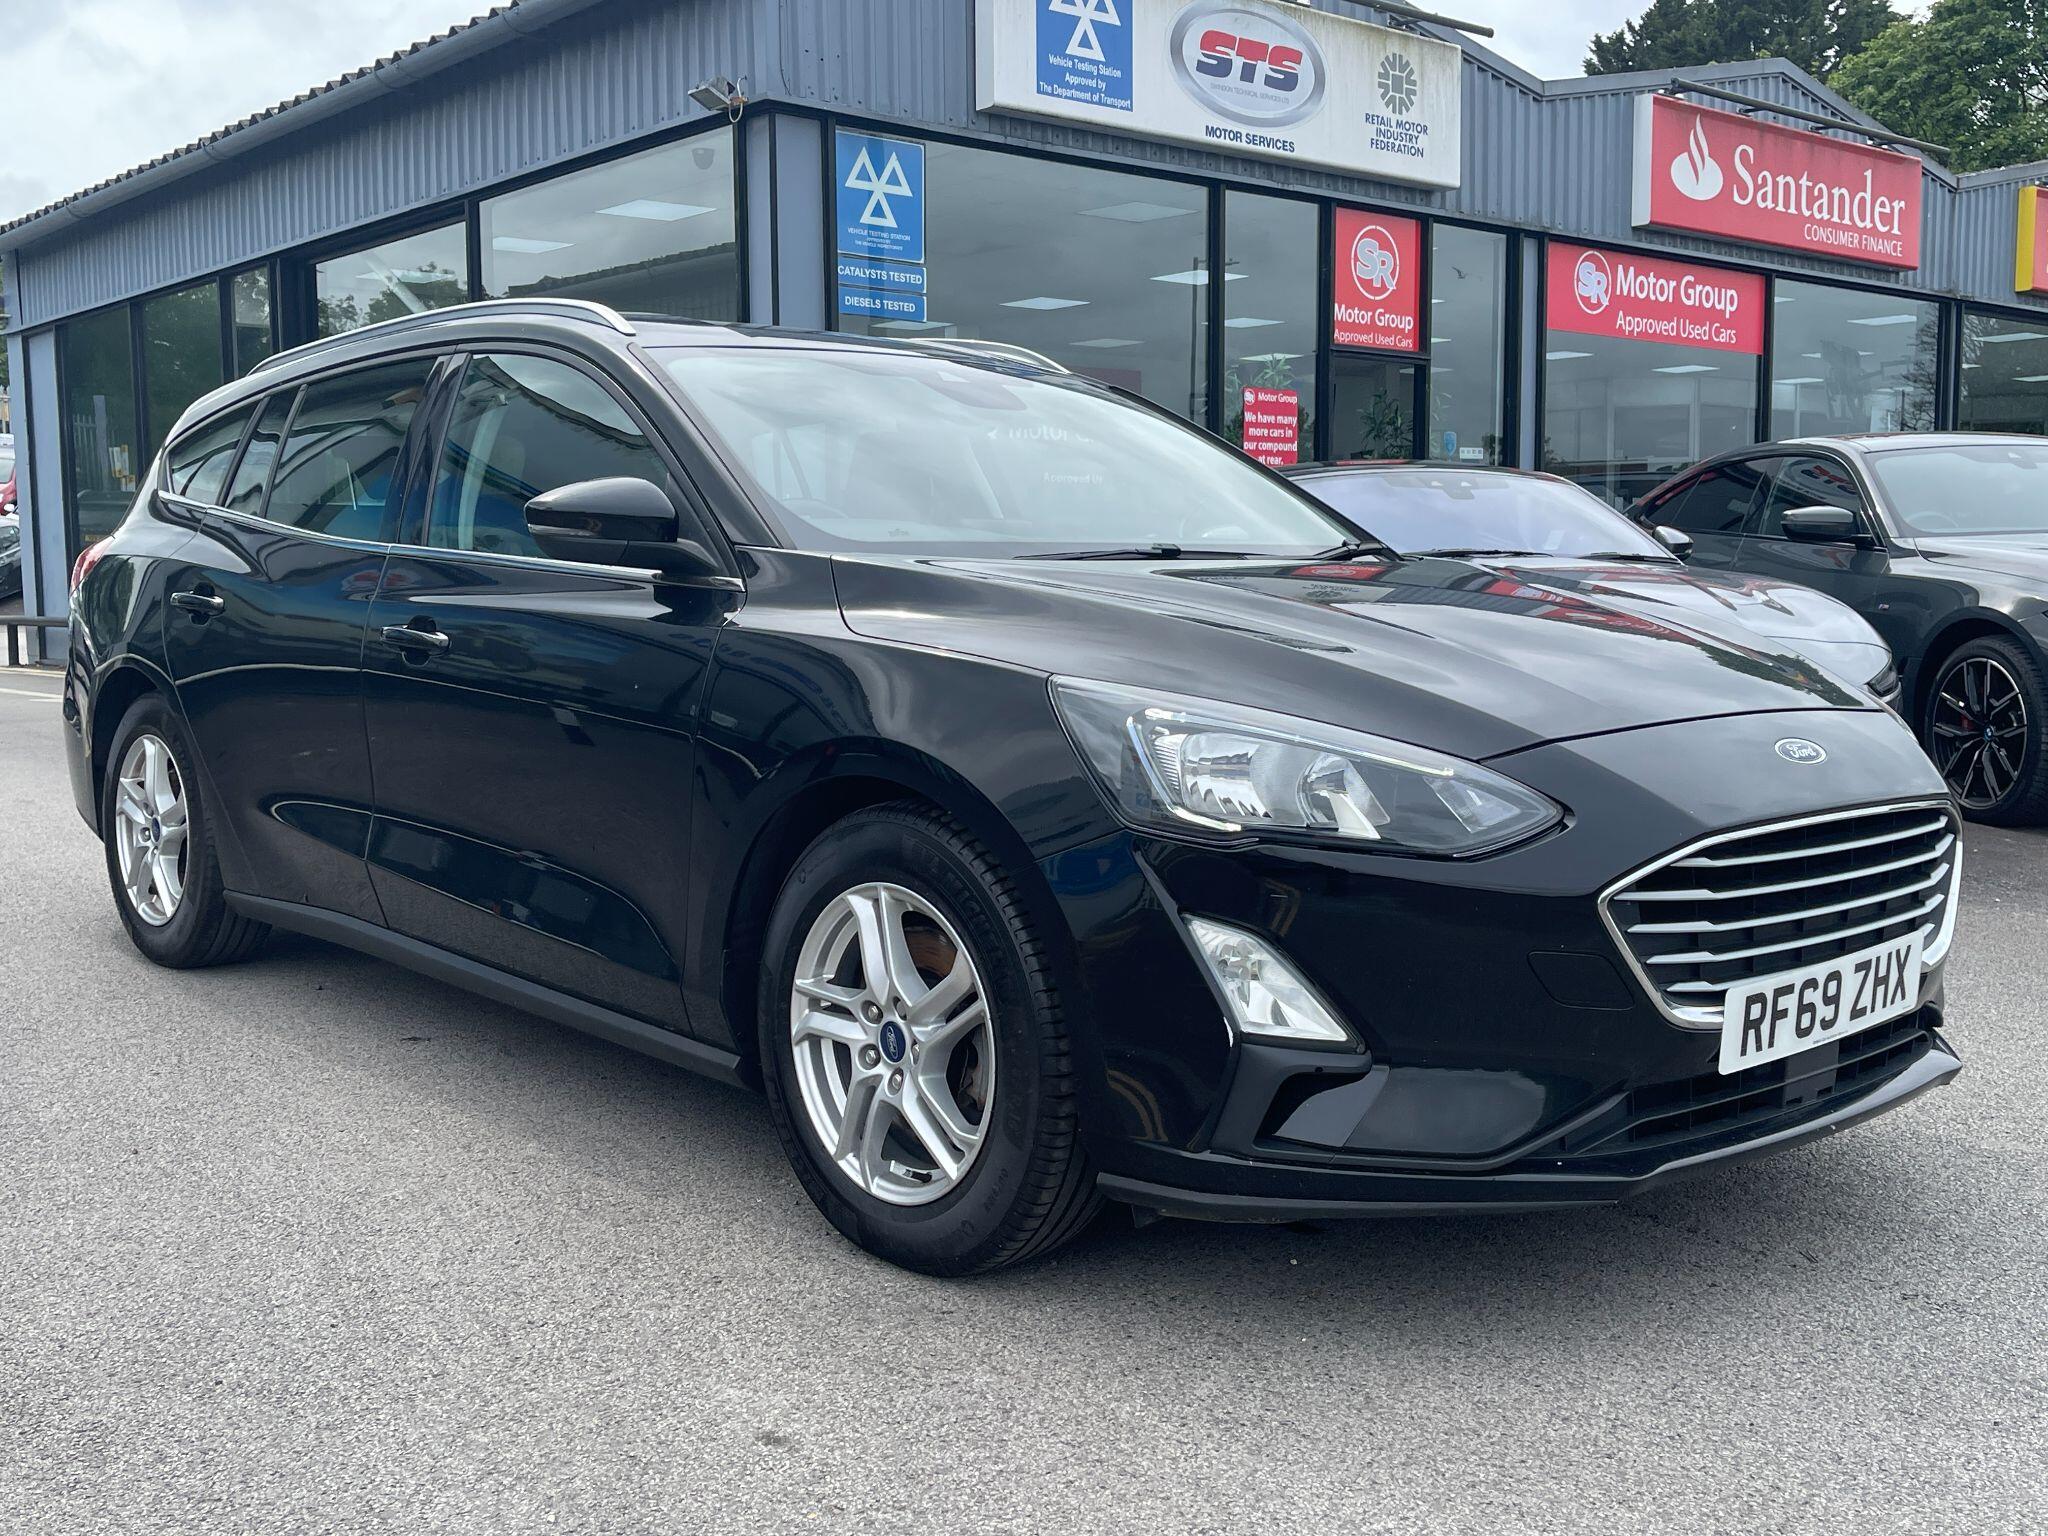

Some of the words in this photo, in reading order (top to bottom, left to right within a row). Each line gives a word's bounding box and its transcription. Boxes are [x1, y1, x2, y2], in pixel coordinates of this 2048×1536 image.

[1048, 53, 1073, 68] Vehicle
[1074, 58, 1098, 75] Testing
[1098, 64, 1121, 78] Station
[1196, 29, 1303, 92] STS
[1065, 72, 1096, 88] Approved
[1098, 78, 1106, 91] by
[1039, 82, 1052, 93] The
[1053, 85, 1091, 100] Department
[1092, 93, 1100, 102] of
[1100, 94, 1131, 109] Transport
[1365, 113, 1393, 128] RETAIL
[1396, 119, 1428, 135] MOTOR
[1205, 125, 1242, 143] MOTOR
[1245, 133, 1295, 153] SERVICES
[1376, 127, 1419, 145] INDUSTRY
[1370, 138, 1424, 158] FEDERATION
[1733, 144, 1905, 236] Santander
[847, 227, 868, 236] VEHICLE
[868, 230, 890, 239] TESTING
[890, 233, 911, 241] STATION
[1804, 223, 1860, 248] CONSUMER
[1862, 234, 1903, 257] FINANCE
[838, 265, 887, 280] CATALYSTS
[889, 271, 923, 284] TESTED
[1356, 238, 1397, 290] SR
[1577, 261, 1610, 306] SR
[1616, 264, 1677, 303] Motor
[1680, 275, 1738, 319] Group
[844, 296, 881, 309] DIESELS
[882, 300, 916, 312] TESTED
[1334, 302, 1372, 324] Motor
[1375, 308, 1414, 333] Group
[1616, 310, 1677, 336] Approved
[1680, 318, 1710, 342] Used
[1711, 323, 1736, 344] Cars
[1333, 329, 1373, 344] Approved
[1375, 333, 1394, 346] Used
[1396, 335, 1413, 348] Cars
[1258, 392, 1277, 402] Motor
[1277, 394, 1297, 404] Group
[1244, 412, 1256, 422] We
[1257, 412, 1275, 424] have
[1276, 416, 1297, 427] many
[1248, 427, 1268, 437] more
[1269, 428, 1284, 438] cars
[1285, 427, 1293, 438] in
[1244, 441, 1256, 450] our
[1258, 441, 1297, 453] compound
[1266, 457, 1283, 465] rear.
[1786, 743, 1817, 758] Ford
[1739, 969, 1843, 1058] RF69
[1849, 944, 1912, 1022] ZHX
